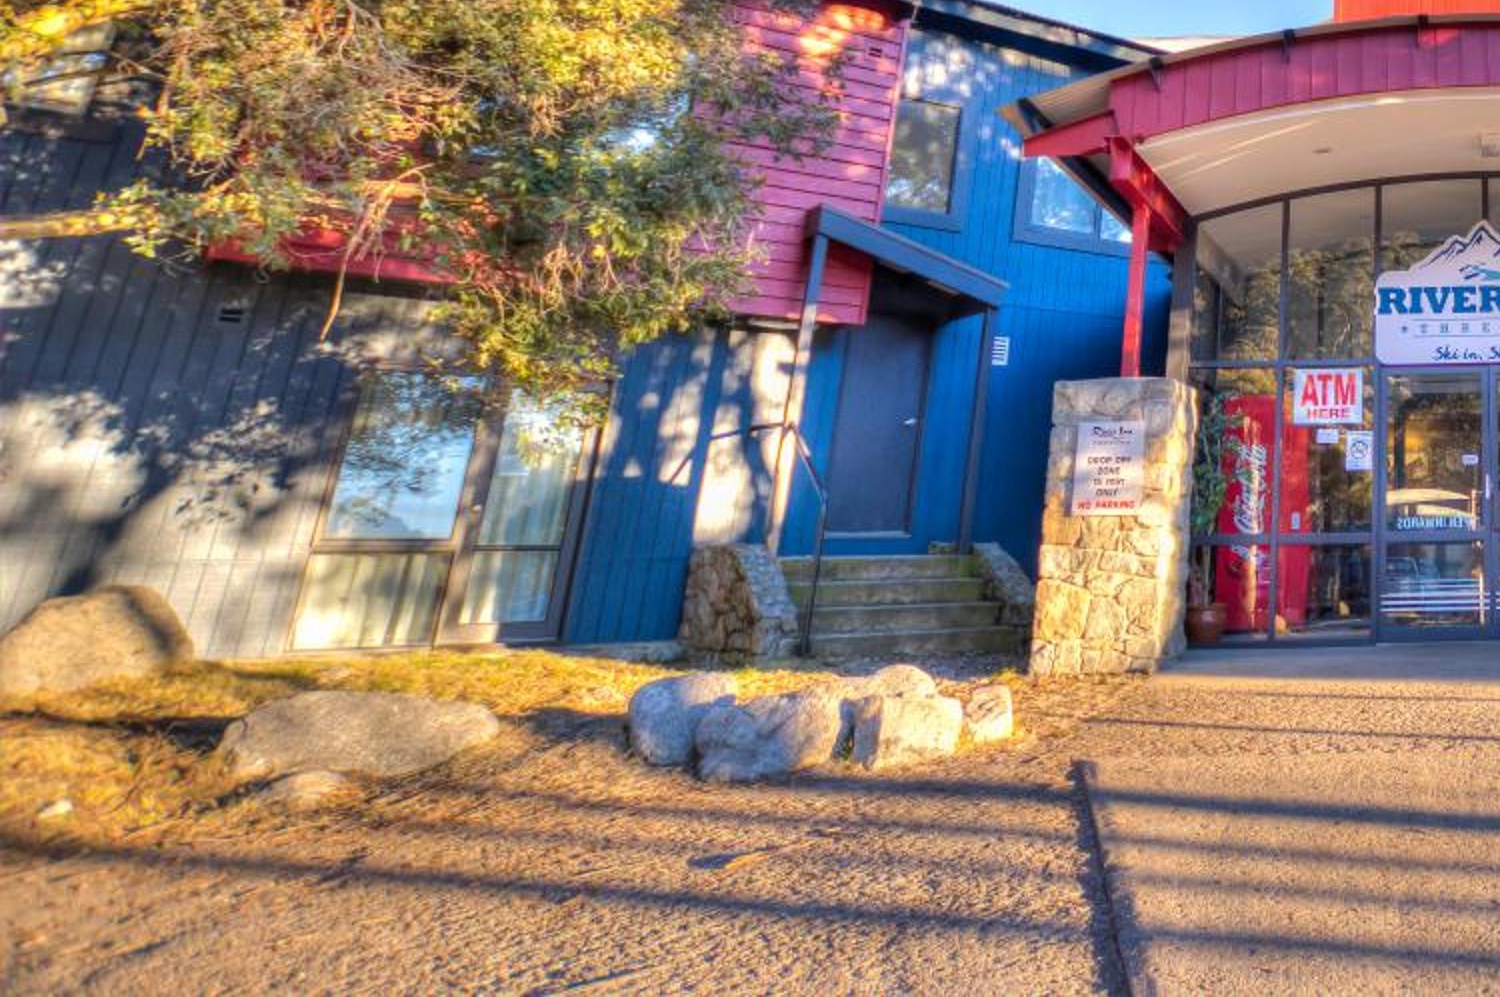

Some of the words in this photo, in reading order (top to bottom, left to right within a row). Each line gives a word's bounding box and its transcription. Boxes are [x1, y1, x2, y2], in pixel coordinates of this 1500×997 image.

[1432, 346, 1458, 361] Ski
[1301, 373, 1357, 407] ATM
[1307, 407, 1351, 419] HERE
[1087, 456, 1112, 464] DROP
[1095, 488, 1119, 497] ONLY
[1078, 500, 1091, 509] NO
[1095, 500, 1136, 509] PARKING
